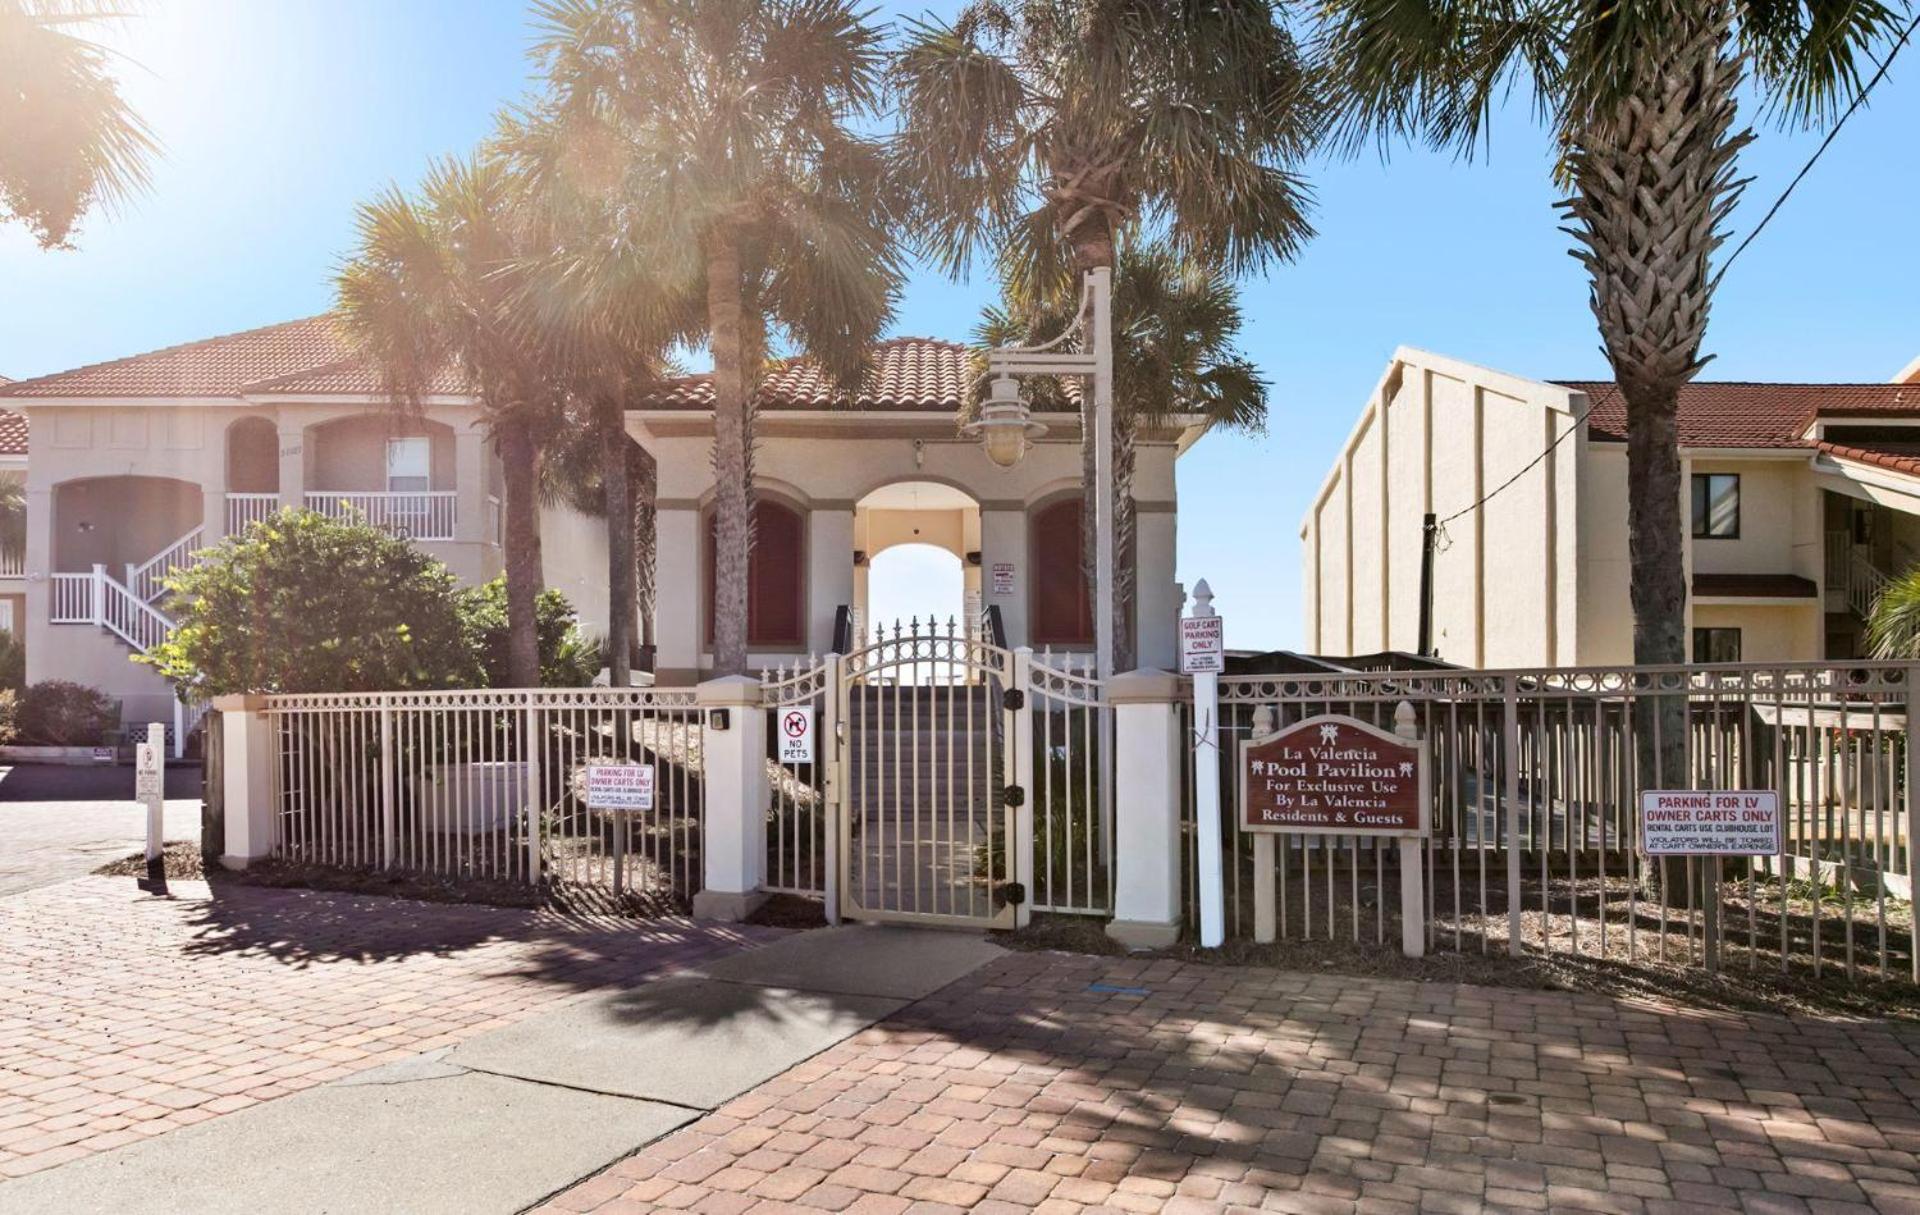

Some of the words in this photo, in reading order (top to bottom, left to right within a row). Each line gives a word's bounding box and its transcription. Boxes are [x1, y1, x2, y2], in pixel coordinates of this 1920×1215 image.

[1184, 621, 1200, 629] GOLF
[1202, 620, 1219, 629] CART
[1184, 630, 1220, 639] PARKING
[1192, 640, 1212, 649] ONLY
[790, 740, 802, 748] NO
[784, 750, 808, 758] PETS
[1284, 747, 1302, 760] La
[1310, 747, 1377, 760] Valencia
[596, 769, 622, 777] PARKING
[624, 769, 635, 777] FOR
[1267, 762, 1307, 776] Pool
[1318, 763, 1397, 778] Pavilion
[614, 778, 634, 786] CARTS
[636, 778, 650, 786] ONLY
[1266, 780, 1290, 791] For
[1298, 780, 1365, 793] Exclusive
[1372, 781, 1398, 793] Use
[1276, 794, 1294, 808] By
[1302, 795, 1318, 806] La
[1325, 795, 1386, 808] Valencia
[1658, 797, 1711, 808] PARKING
[1716, 797, 1739, 808] FOR
[1745, 797, 1759, 808] LV
[1262, 809, 1329, 822] Residents
[1335, 812, 1347, 822] &
[1354, 812, 1403, 824] Guests
[1647, 810, 1691, 821] OWNER
[1696, 810, 1737, 821] CARTS
[1742, 810, 1772, 822] ONLY
[1647, 824, 1672, 832] RENTAL
[1675, 824, 1697, 832] CARTS
[1700, 824, 1713, 832] USE
[1716, 824, 1758, 833] CLUBHOUSE
[1760, 824, 1773, 833] LOT
